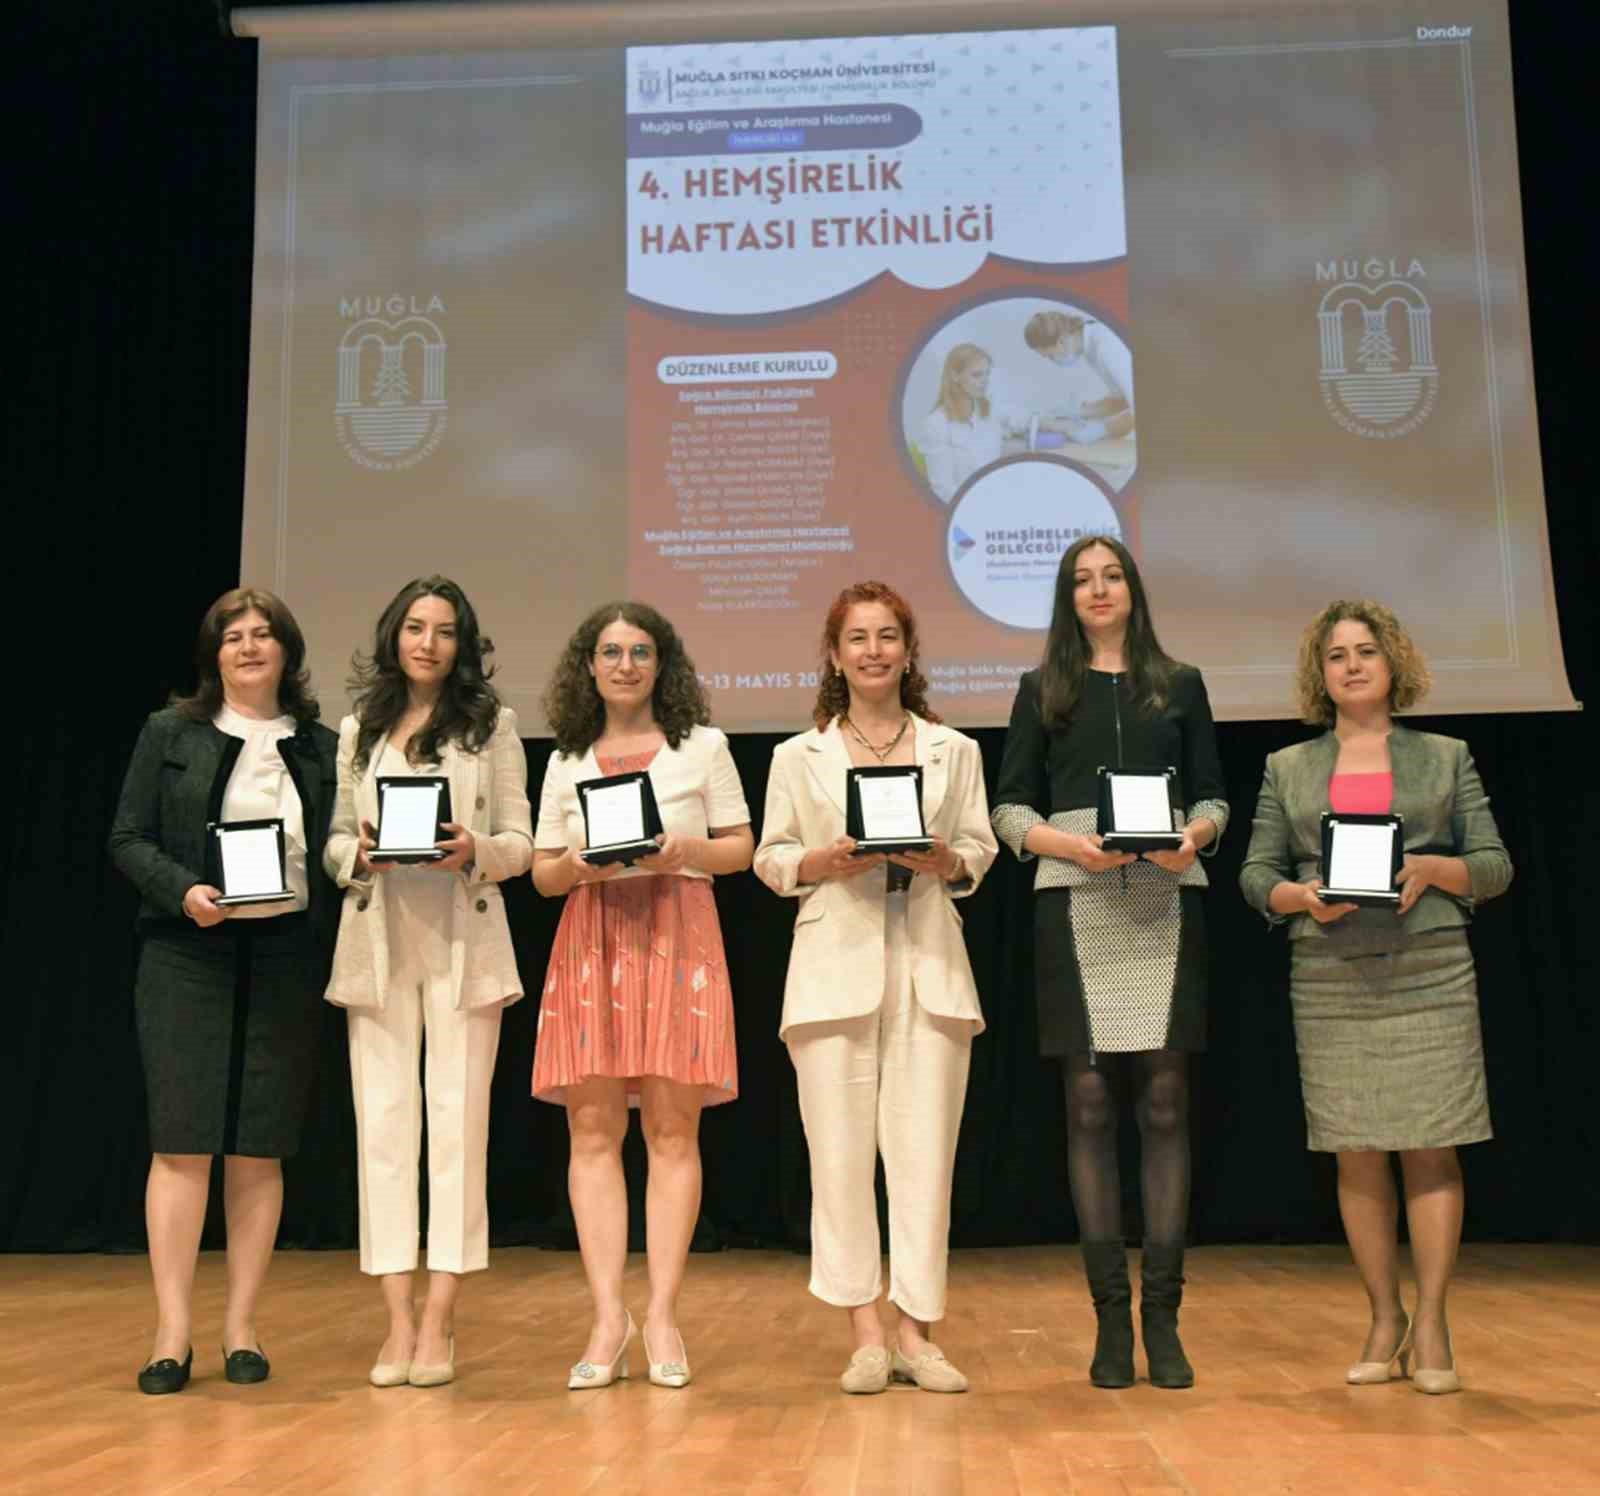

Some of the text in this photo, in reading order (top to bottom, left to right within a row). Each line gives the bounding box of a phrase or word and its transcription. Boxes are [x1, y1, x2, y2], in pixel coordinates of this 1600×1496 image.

[1416, 25, 1472, 40] Dondur
[675, 60, 936, 84] MUĞLA SITKI KOÇMAN ÜNİVERSİTESİ
[640, 111, 892, 136] Muğla Eğitim ve Araştırma Hastanesi
[637, 154, 903, 204] 4. HEMŞİRELİK
[640, 203, 994, 254] HAFTASI ETKİNLİĞİ
[665, 358, 829, 377] DÜZENLEME KURULU
[735, 672, 792, 688] MAYIS
[797, 671, 821, 688] 20
